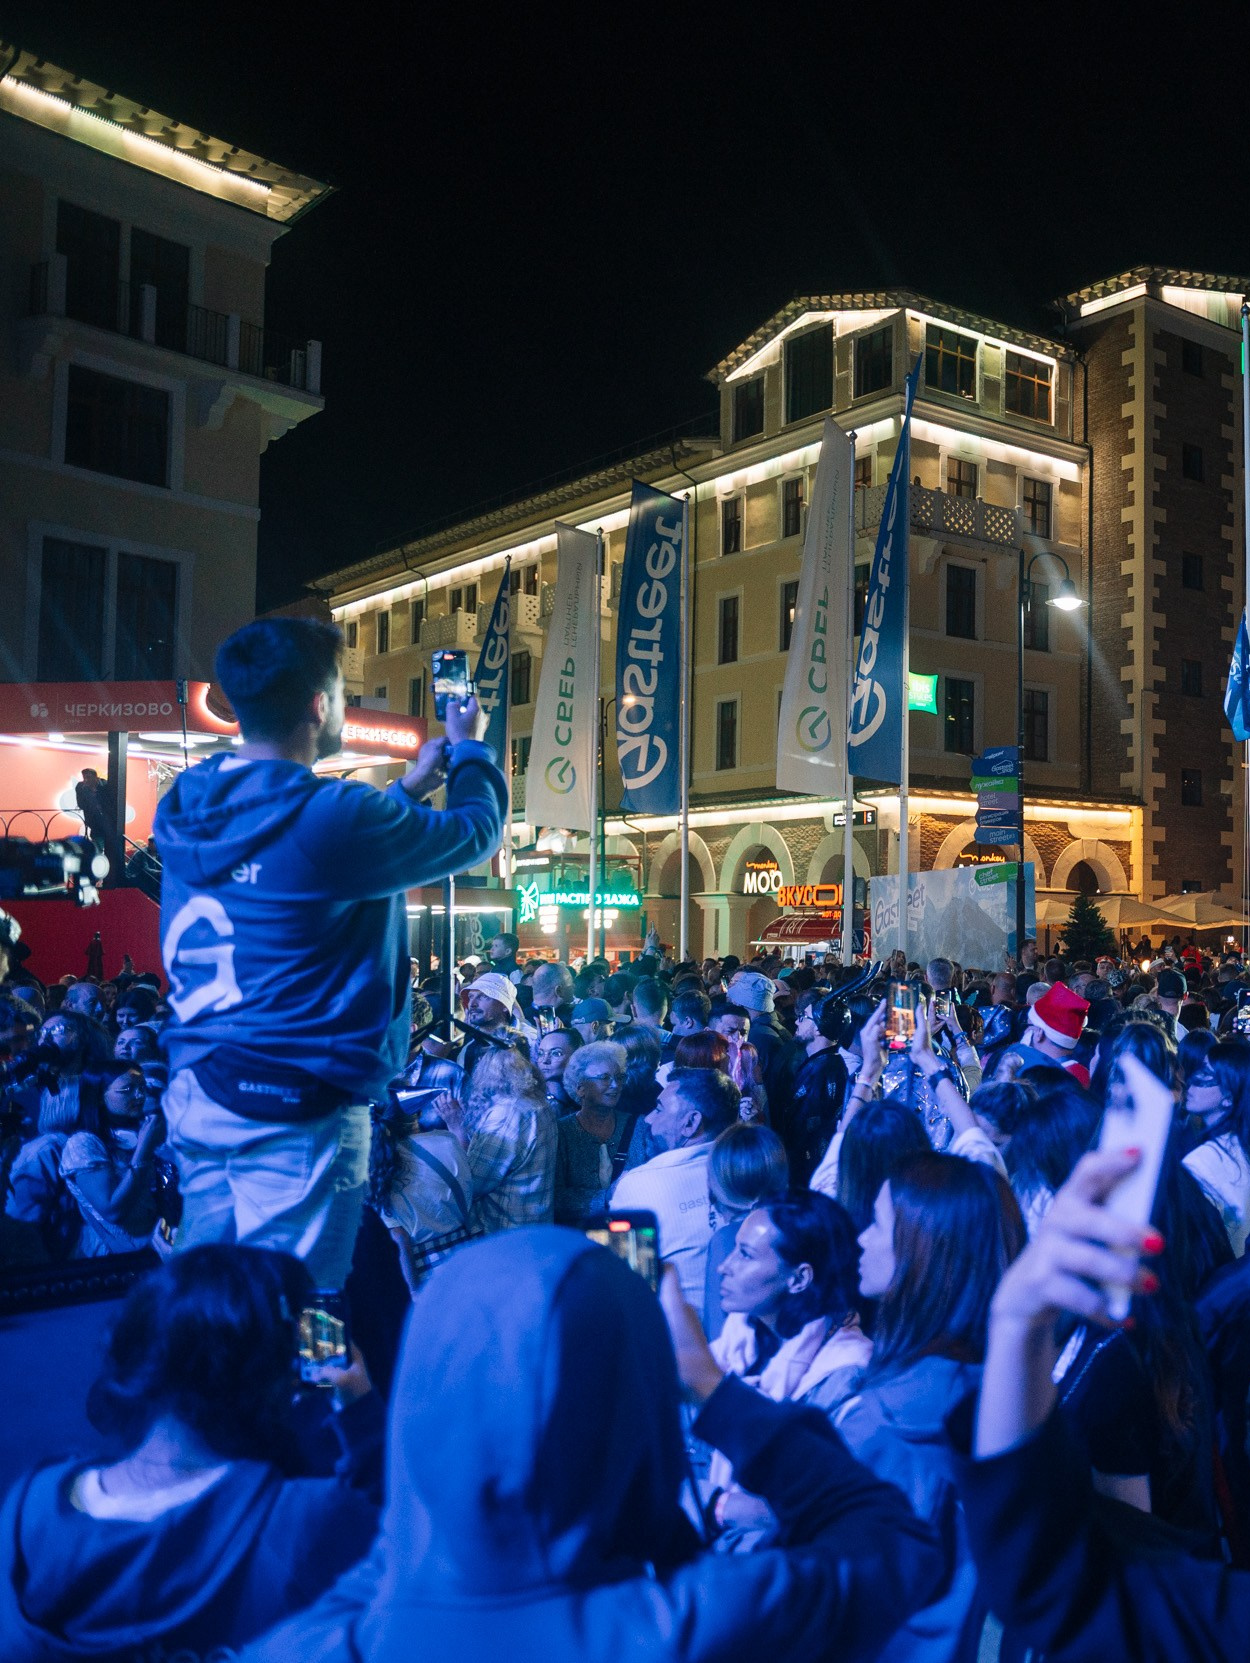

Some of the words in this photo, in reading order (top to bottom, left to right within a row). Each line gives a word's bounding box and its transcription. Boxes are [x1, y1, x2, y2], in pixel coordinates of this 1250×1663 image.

[64, 702, 173, 717] ЧЕРКИЗОВО
[343, 725, 418, 746] ЕРКИЗОВО
[980, 792, 996, 800] hotel
[867, 812, 873, 823] 5
[989, 829, 1006, 838] main
